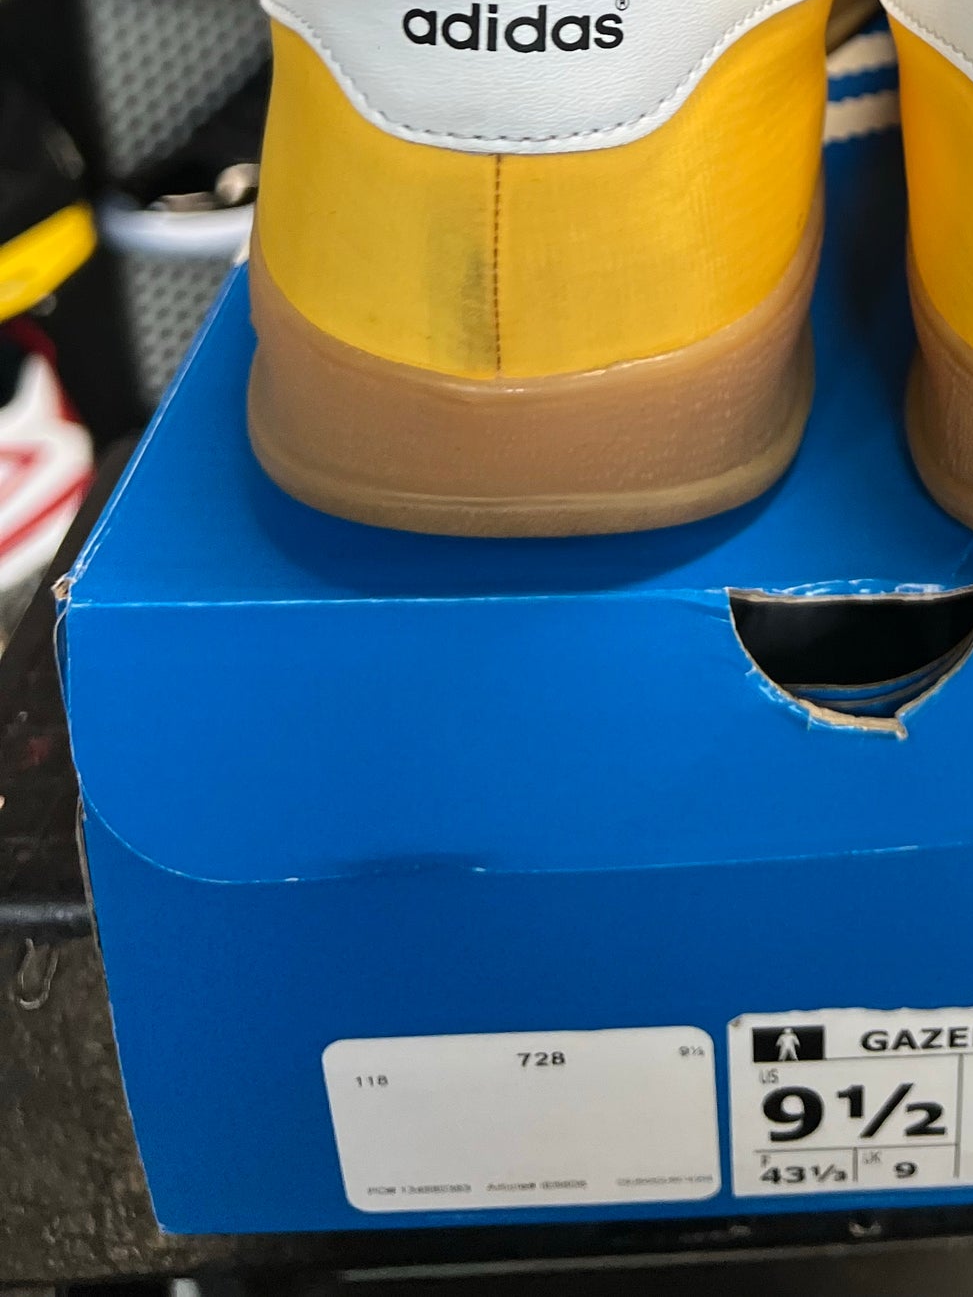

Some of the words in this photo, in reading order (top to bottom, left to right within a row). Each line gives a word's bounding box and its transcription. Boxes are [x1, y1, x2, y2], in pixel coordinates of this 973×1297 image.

[402, 3, 624, 53] adidas
[517, 1051, 567, 1068] 728
[355, 1074, 389, 1088] 118
[894, 1161, 918, 1180] 9
